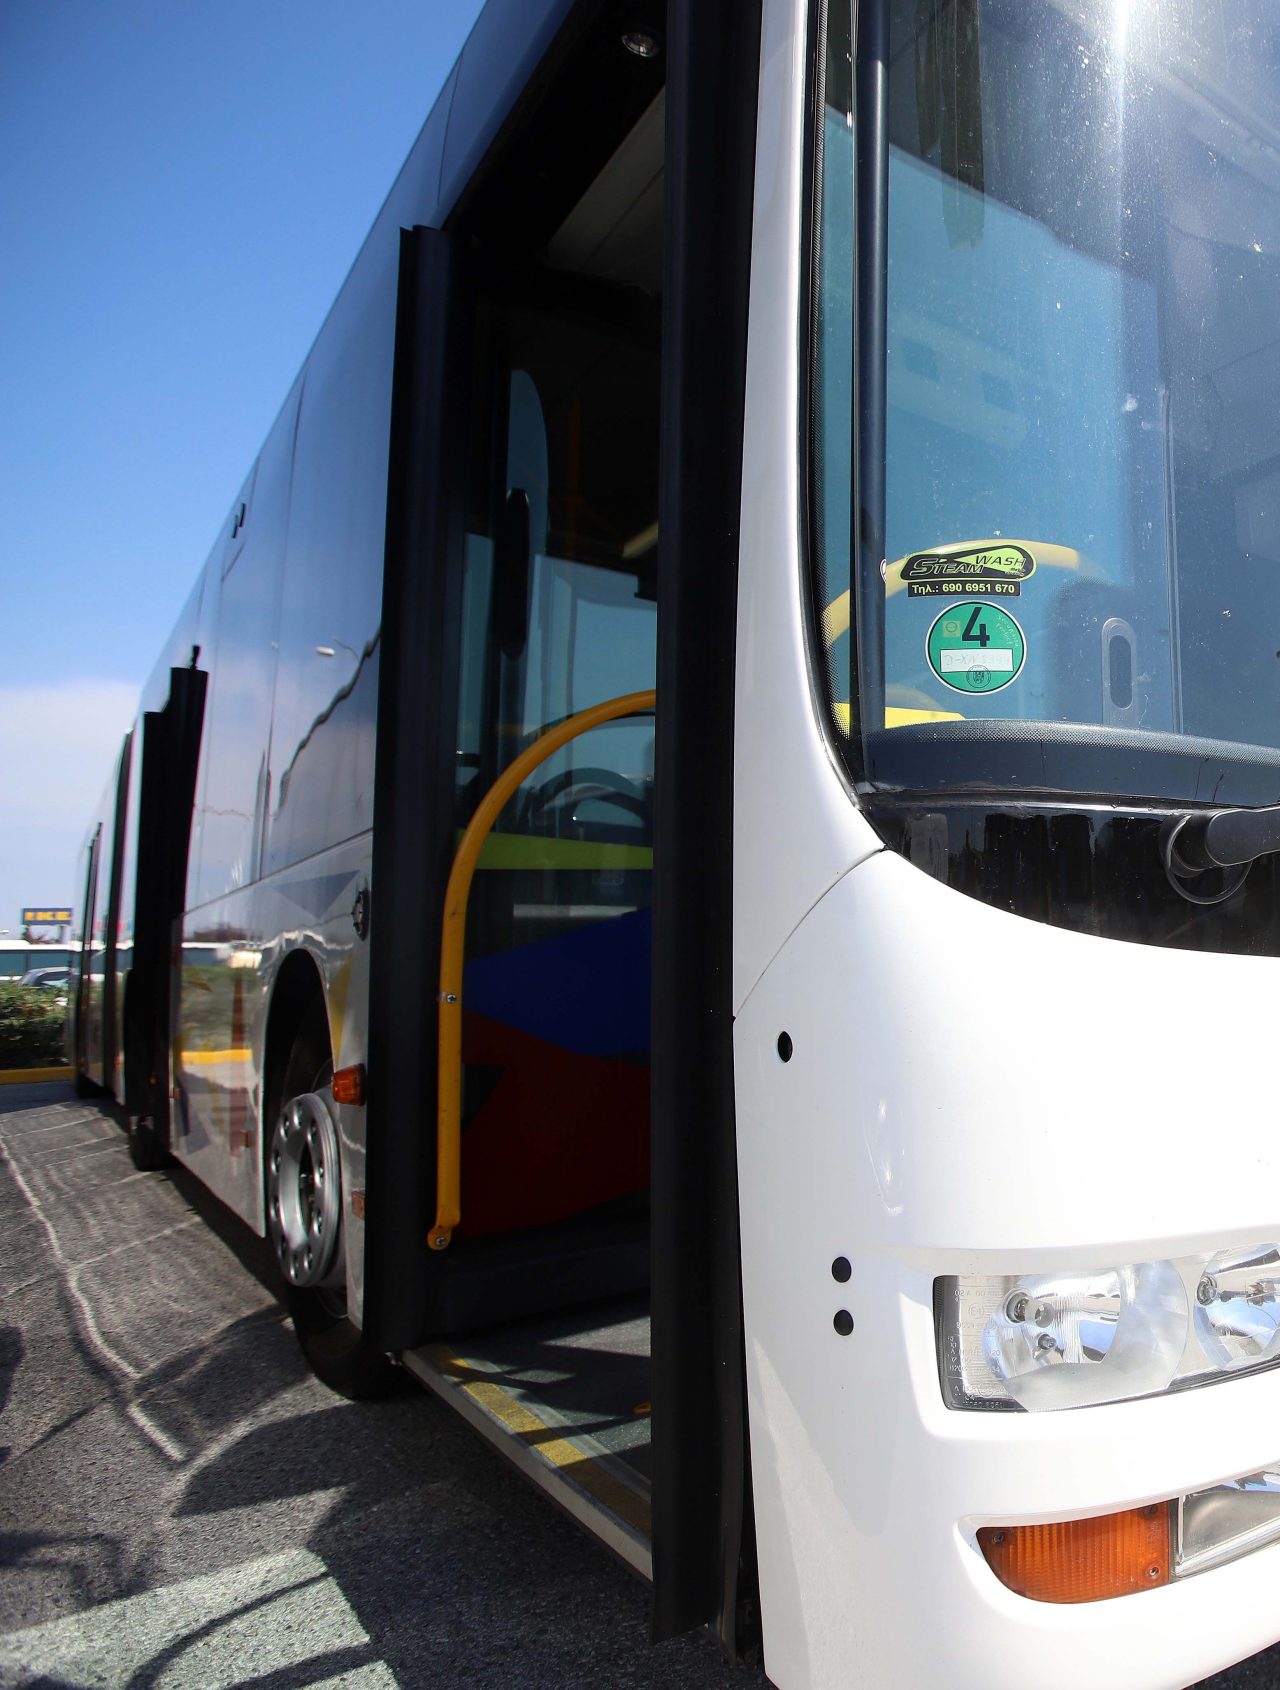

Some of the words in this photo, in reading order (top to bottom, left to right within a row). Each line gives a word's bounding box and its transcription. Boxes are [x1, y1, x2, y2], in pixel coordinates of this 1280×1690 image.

[909, 558, 984, 577] STEAM
[975, 555, 1026, 567] WASH
[942, 583, 963, 592] 690
[965, 583, 991, 592] 6951
[995, 584, 1015, 593] 670
[961, 606, 991, 648] 4
